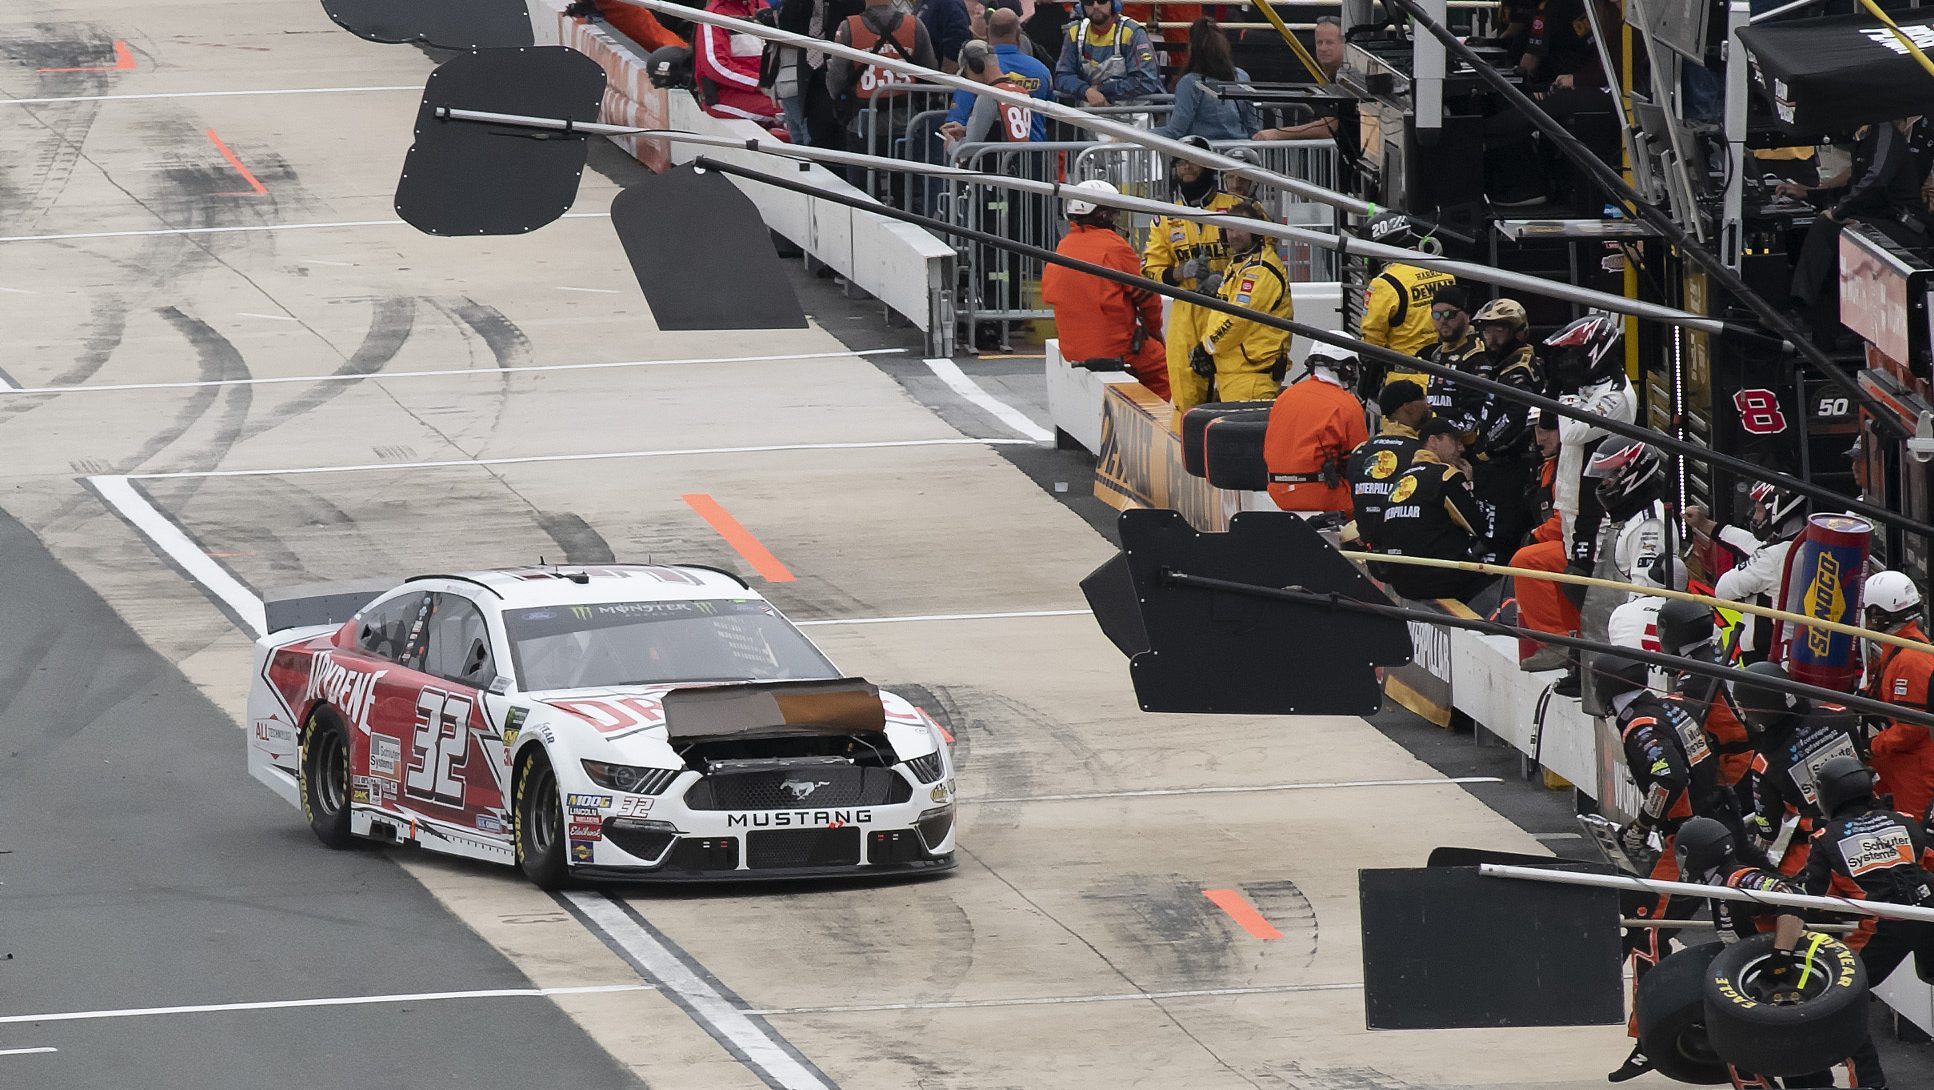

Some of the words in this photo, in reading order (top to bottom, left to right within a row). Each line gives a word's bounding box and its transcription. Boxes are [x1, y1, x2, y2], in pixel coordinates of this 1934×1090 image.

[658, 61, 671, 71] 9
[1372, 220, 1388, 238] 20
[1733, 388, 1787, 434] 8
[1818, 398, 1849, 416] 50
[1355, 482, 1394, 495] CATERPILL
[1384, 505, 1421, 522] ERPILLAR
[599, 602, 692, 614] MONSTER
[1407, 620, 1450, 684] ERPILLAR
[305, 651, 389, 737] DRYDENE
[255, 721, 270, 741] ALL
[404, 684, 474, 811] 32
[569, 795, 610, 808] MOOG
[616, 797, 654, 818] 32
[569, 807, 598, 816] LINCOLN
[728, 809, 872, 827] MUSTANG
[1847, 848, 1897, 868] Systems
[1705, 977, 1758, 1009] EAGLE
